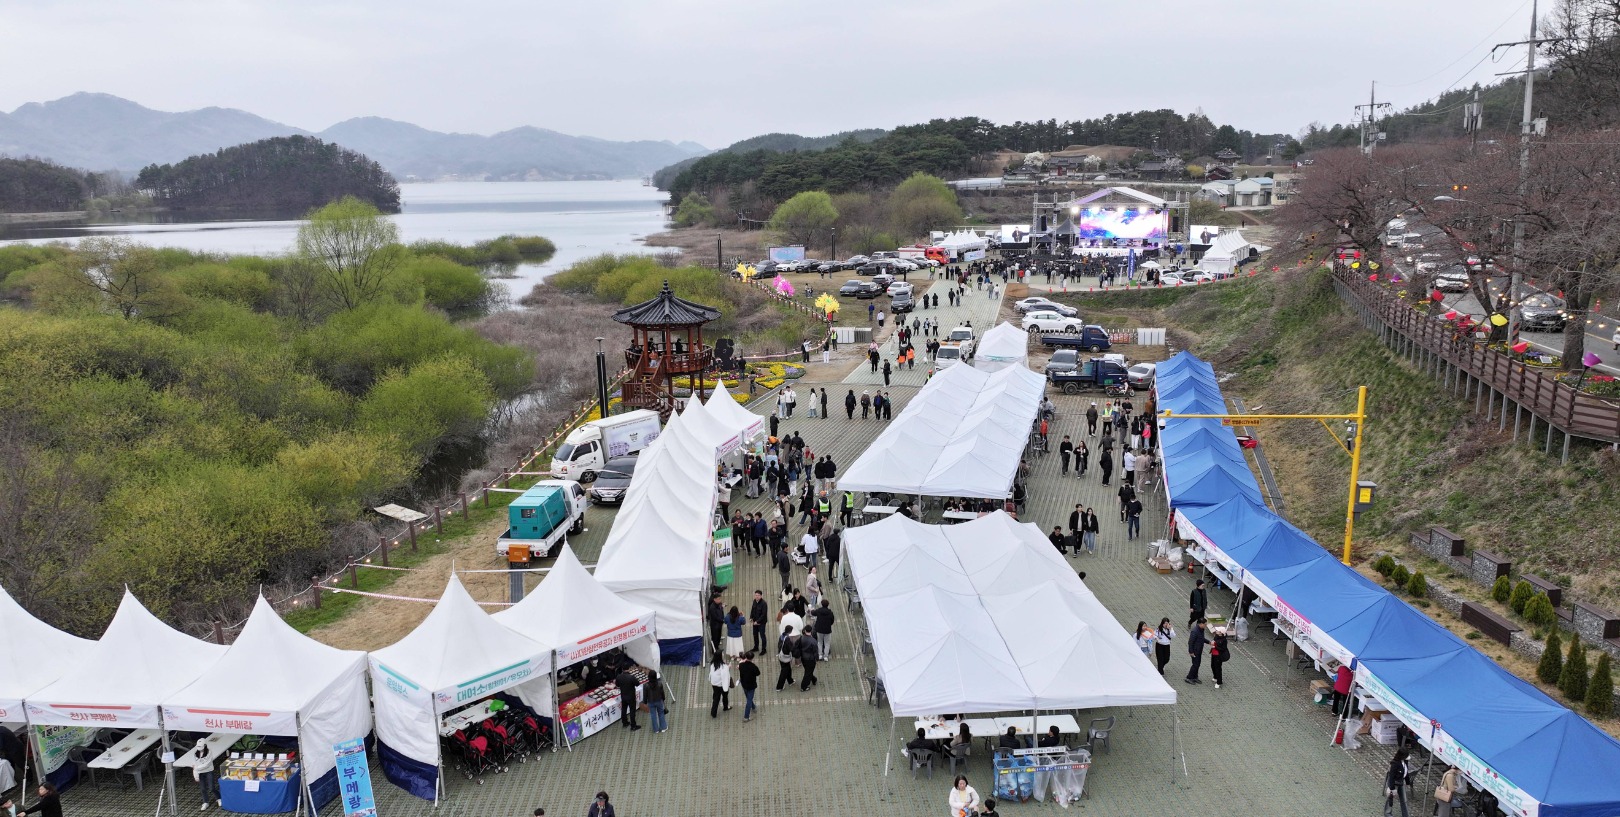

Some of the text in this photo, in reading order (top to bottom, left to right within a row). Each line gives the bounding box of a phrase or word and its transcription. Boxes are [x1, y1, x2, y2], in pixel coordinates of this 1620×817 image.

[70, 711, 118, 722] 천사 부메랑
[205, 718, 253, 730] 천사 부메랑
[343, 766, 362, 810] 부메랑
